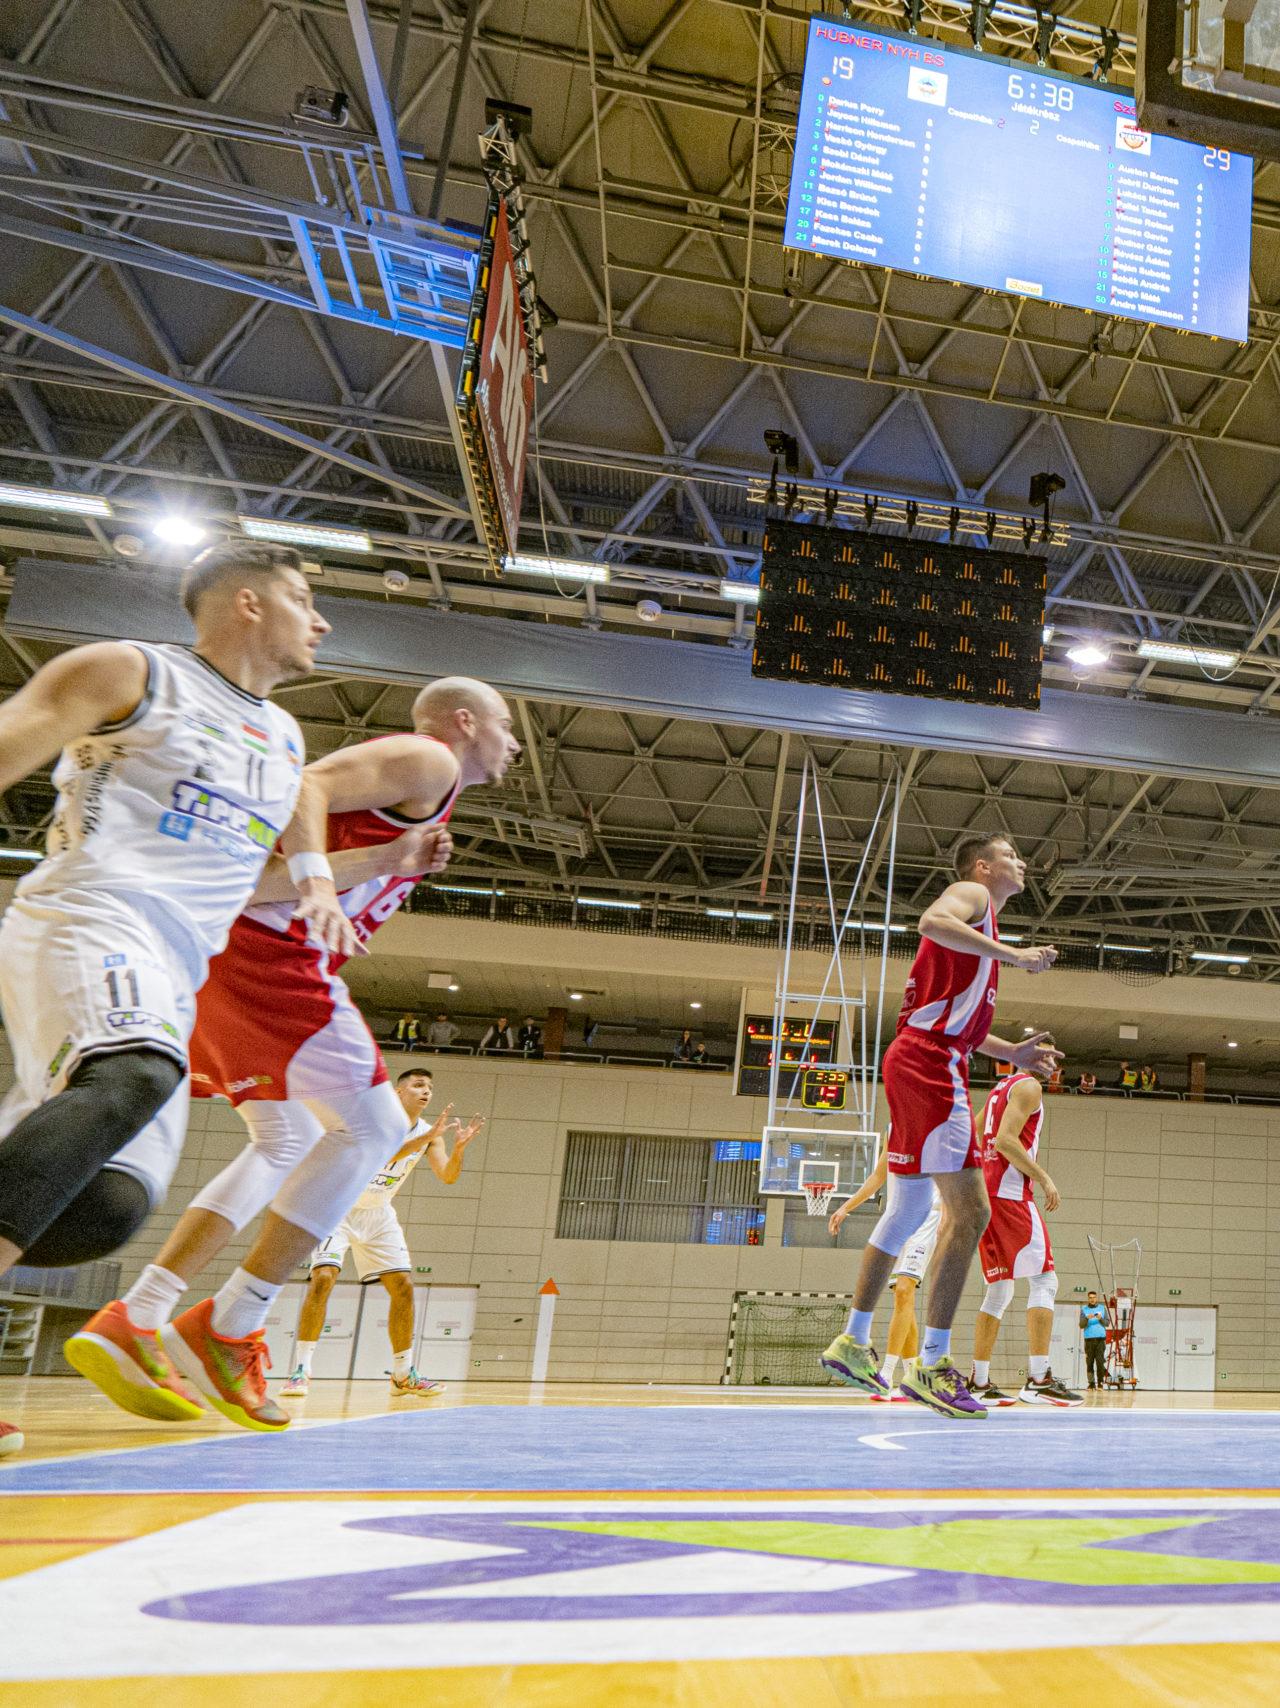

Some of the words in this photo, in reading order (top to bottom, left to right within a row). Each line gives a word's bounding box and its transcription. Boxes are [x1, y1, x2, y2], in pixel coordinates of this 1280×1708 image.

[816, 25, 883, 51] HÜBNER
[886, 43, 920, 61] NYH
[924, 52, 945, 68] BS
[832, 56, 854, 80] 19
[1008, 74, 1074, 111] 6:38
[997, 118, 1006, 129] 2
[1029, 119, 1040, 135] 2
[1203, 146, 1231, 171] 29
[104, 968, 140, 1008] 11
